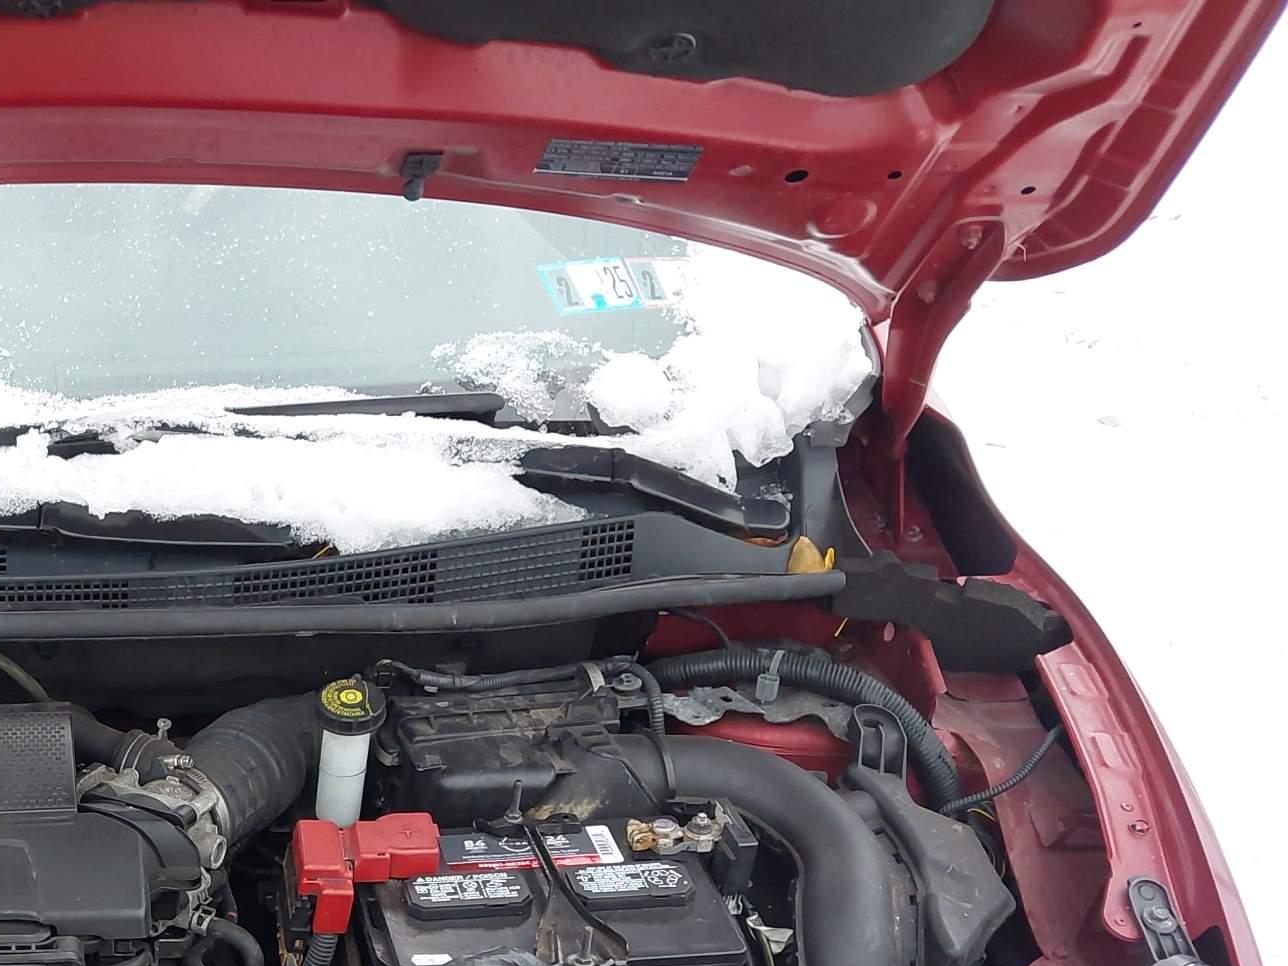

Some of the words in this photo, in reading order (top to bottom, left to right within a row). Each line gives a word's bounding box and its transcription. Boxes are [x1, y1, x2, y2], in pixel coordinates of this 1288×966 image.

[556, 276, 579, 306] 2
[603, 265, 634, 299] 25
[641, 270, 663, 300] 2
